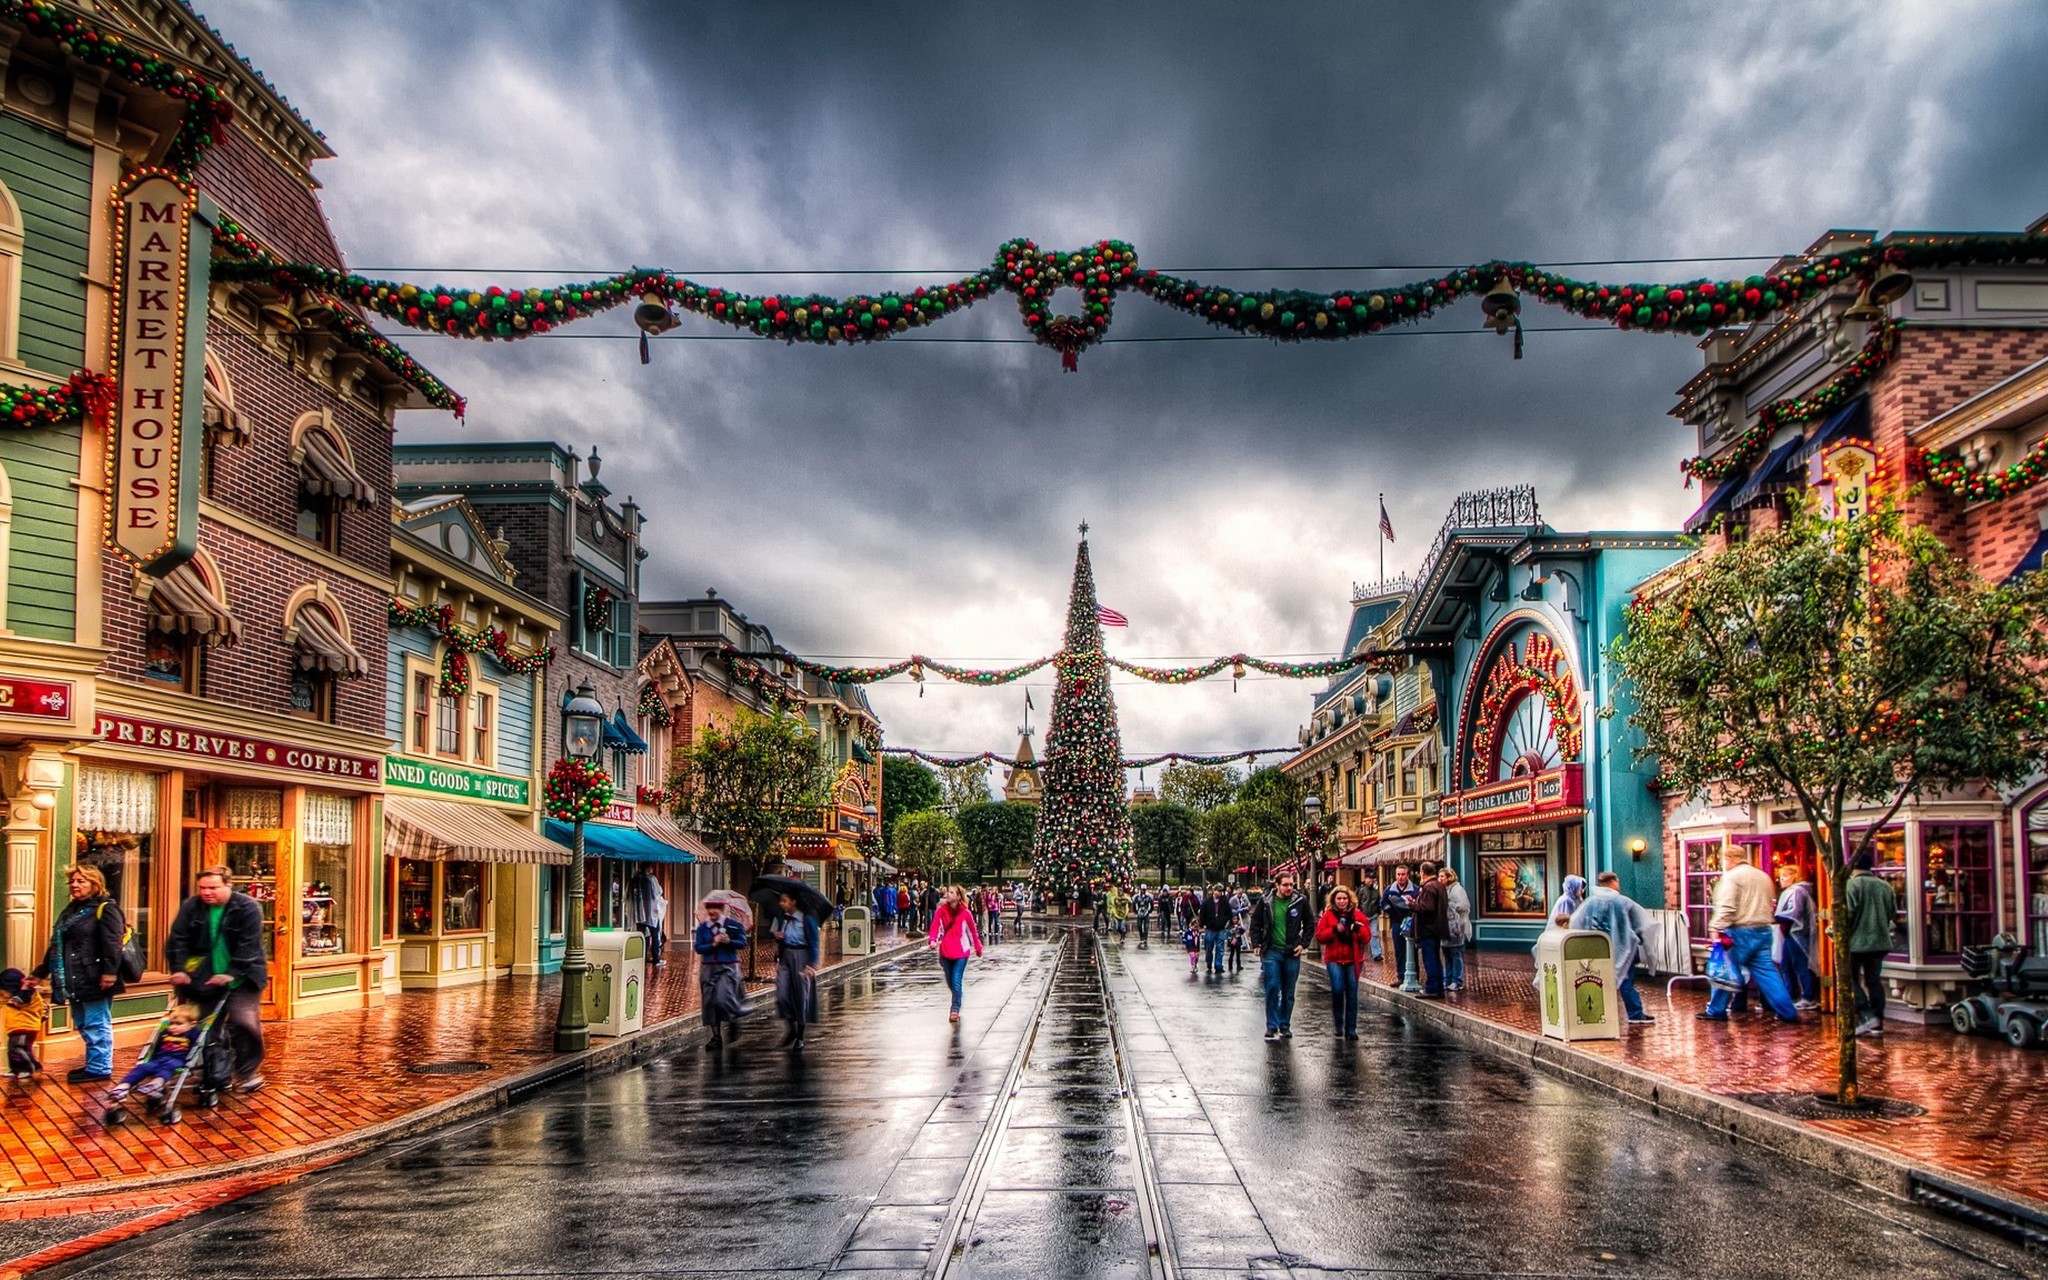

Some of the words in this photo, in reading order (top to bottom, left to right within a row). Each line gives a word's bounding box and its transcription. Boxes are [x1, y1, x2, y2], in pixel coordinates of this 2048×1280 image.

[134, 201, 176, 370] MARKET
[128, 388, 165, 529] HOUSE
[98, 718, 257, 760] PRESERVES
[286, 750, 363, 776] COFFEE
[387, 762, 426, 785] NNED
[429, 769, 471, 792] GOODS
[485, 780, 520, 800] SPICES
[1468, 787, 1529, 811] DISNEYLAND
